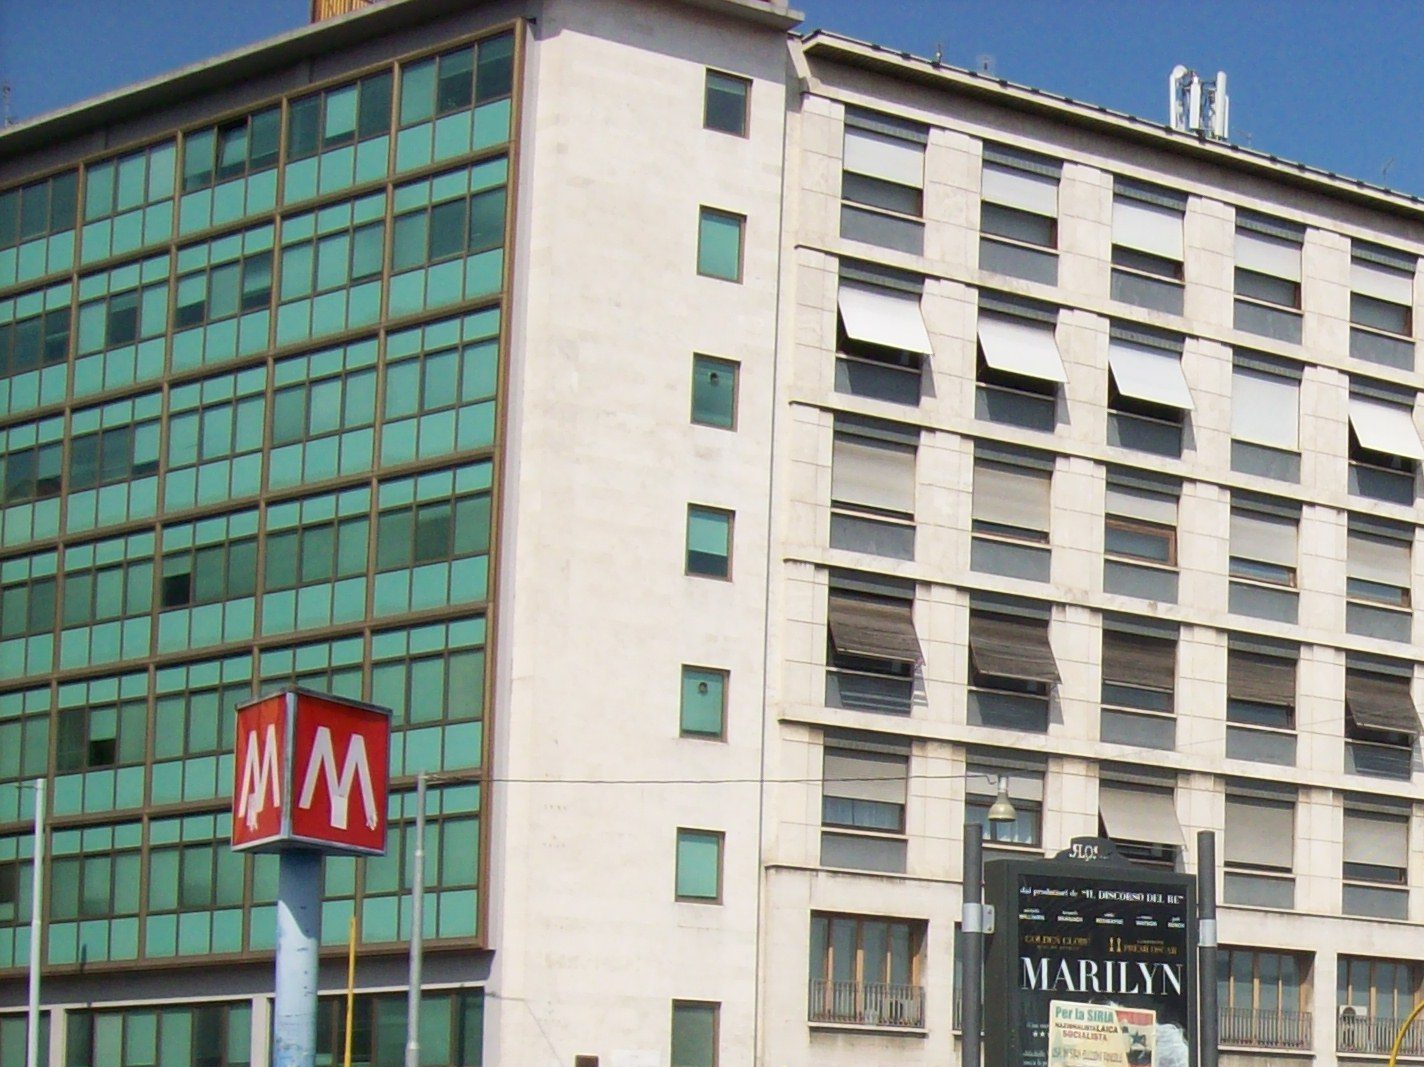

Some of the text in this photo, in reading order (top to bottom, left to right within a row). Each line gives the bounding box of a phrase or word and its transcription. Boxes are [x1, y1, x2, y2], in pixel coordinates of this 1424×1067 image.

[298, 726, 378, 830] M
[1098, 890, 1144, 901] DISCORSO
[1146, 893, 1165, 903] DEL
[1020, 956, 1184, 996] MARILYN
[1055, 1006, 1114, 1023] Per la SIRIA
[1062, 1030, 1108, 1041] SOCIALISTA
[1096, 1025, 1118, 1033] LAICA
